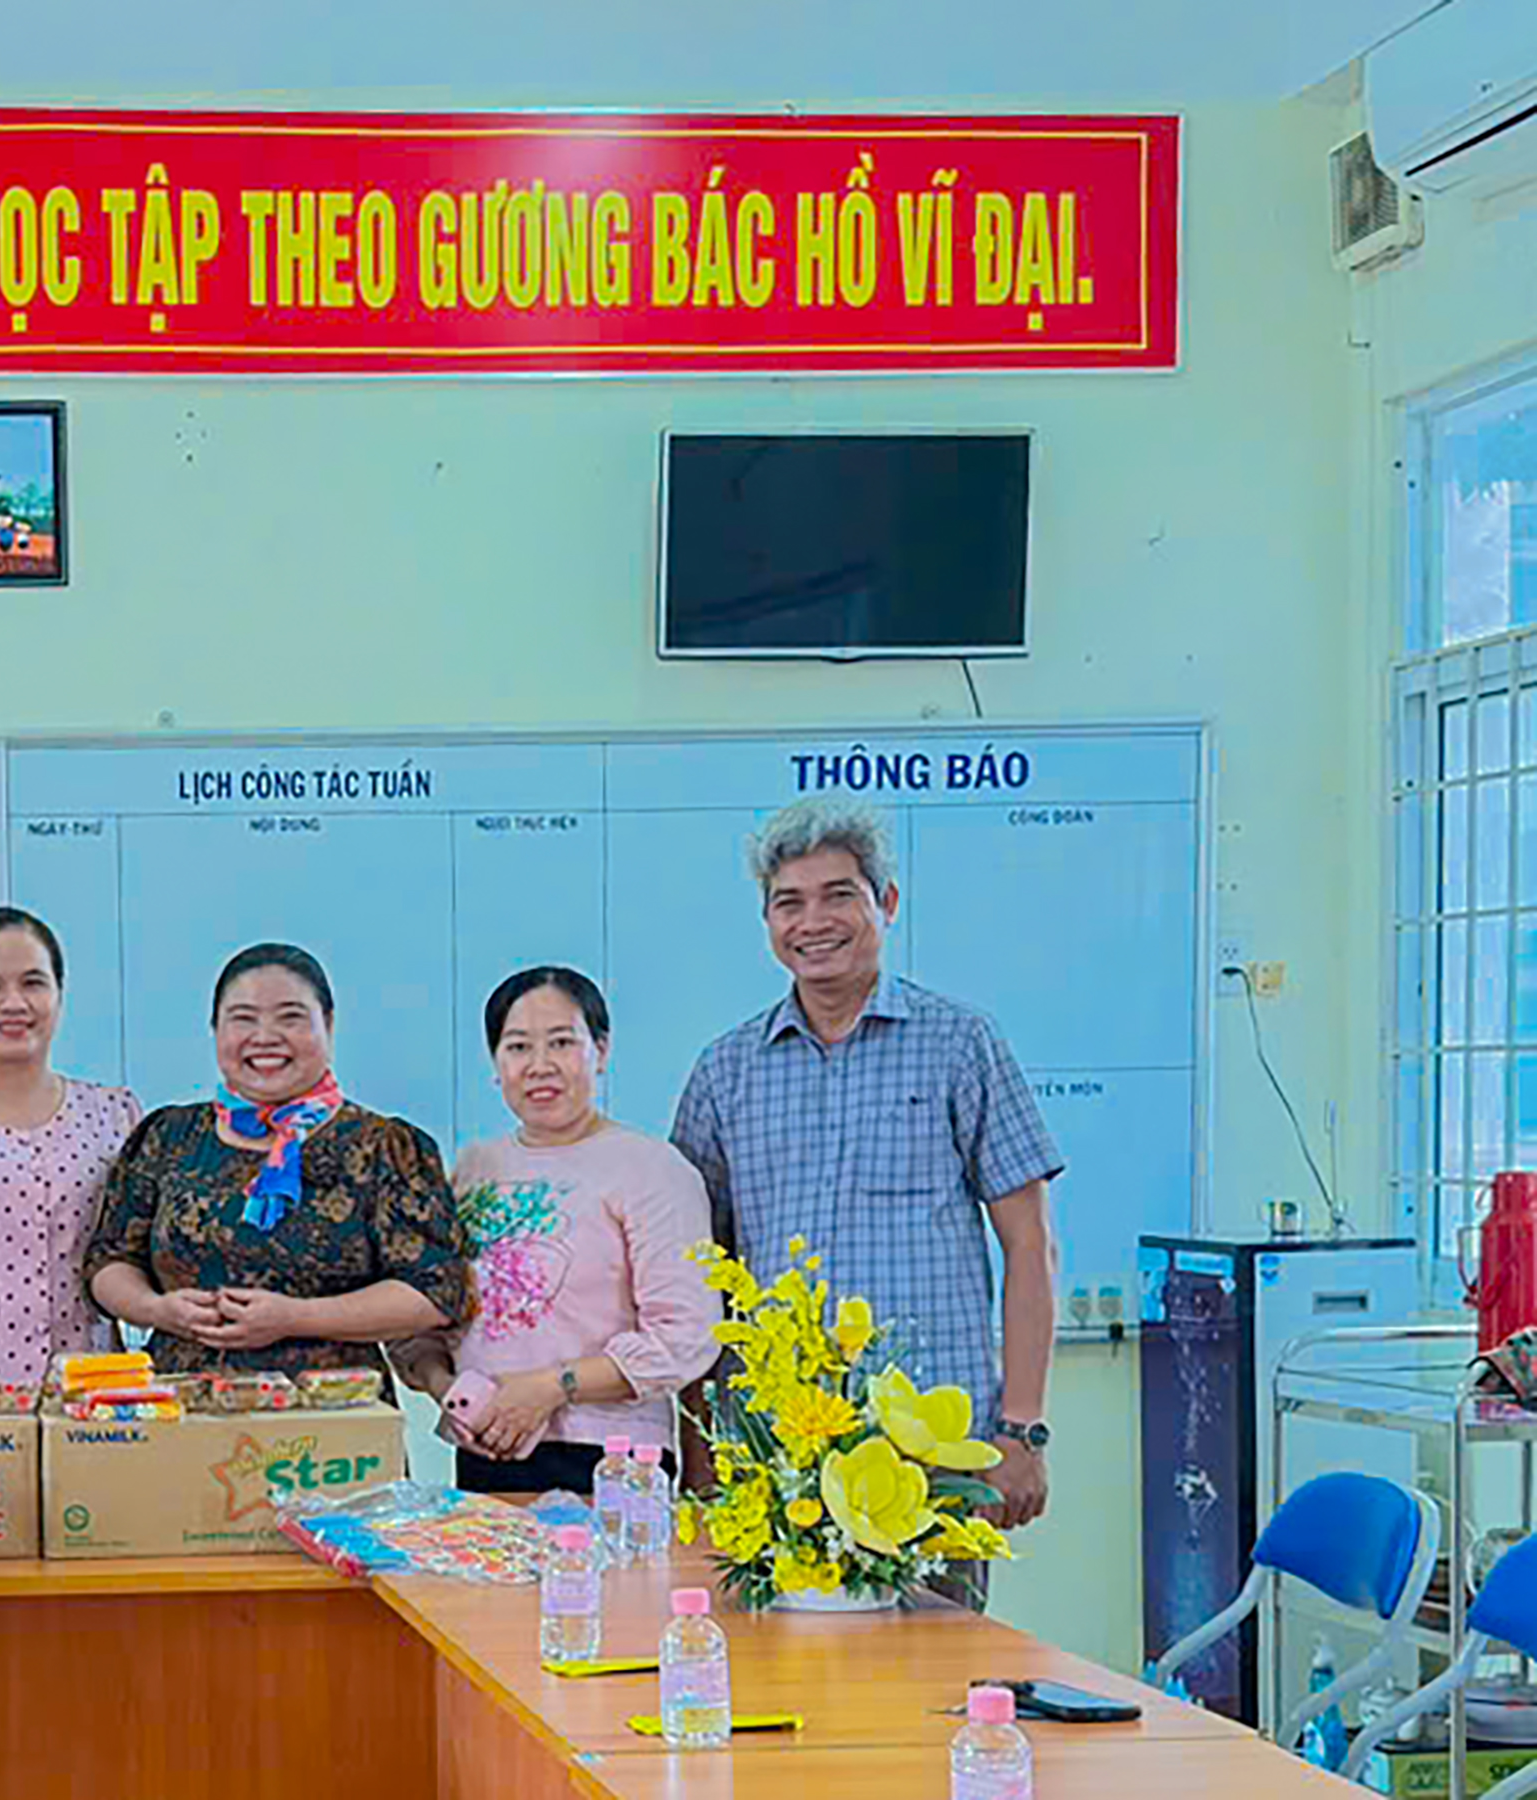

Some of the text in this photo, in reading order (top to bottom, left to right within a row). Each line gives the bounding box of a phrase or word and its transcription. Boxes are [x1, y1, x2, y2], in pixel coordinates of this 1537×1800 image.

[102, 163, 221, 333] TẬP
[241, 190, 398, 309] THEO
[419, 178, 633, 310] GƯƠNG
[652, 166, 776, 308] BÁC
[796, 153, 877, 308] HỒ
[898, 167, 960, 308] VĨ
[974, 192, 1095, 331] ĐẠI.
[179, 759, 432, 805] LỊCH CÔNG TÁC TUẦN
[791, 744, 1030, 792] THÔNG BÁO
[66, 1429, 141, 1443] VINAMILK
[266, 1452, 380, 1492] Star
